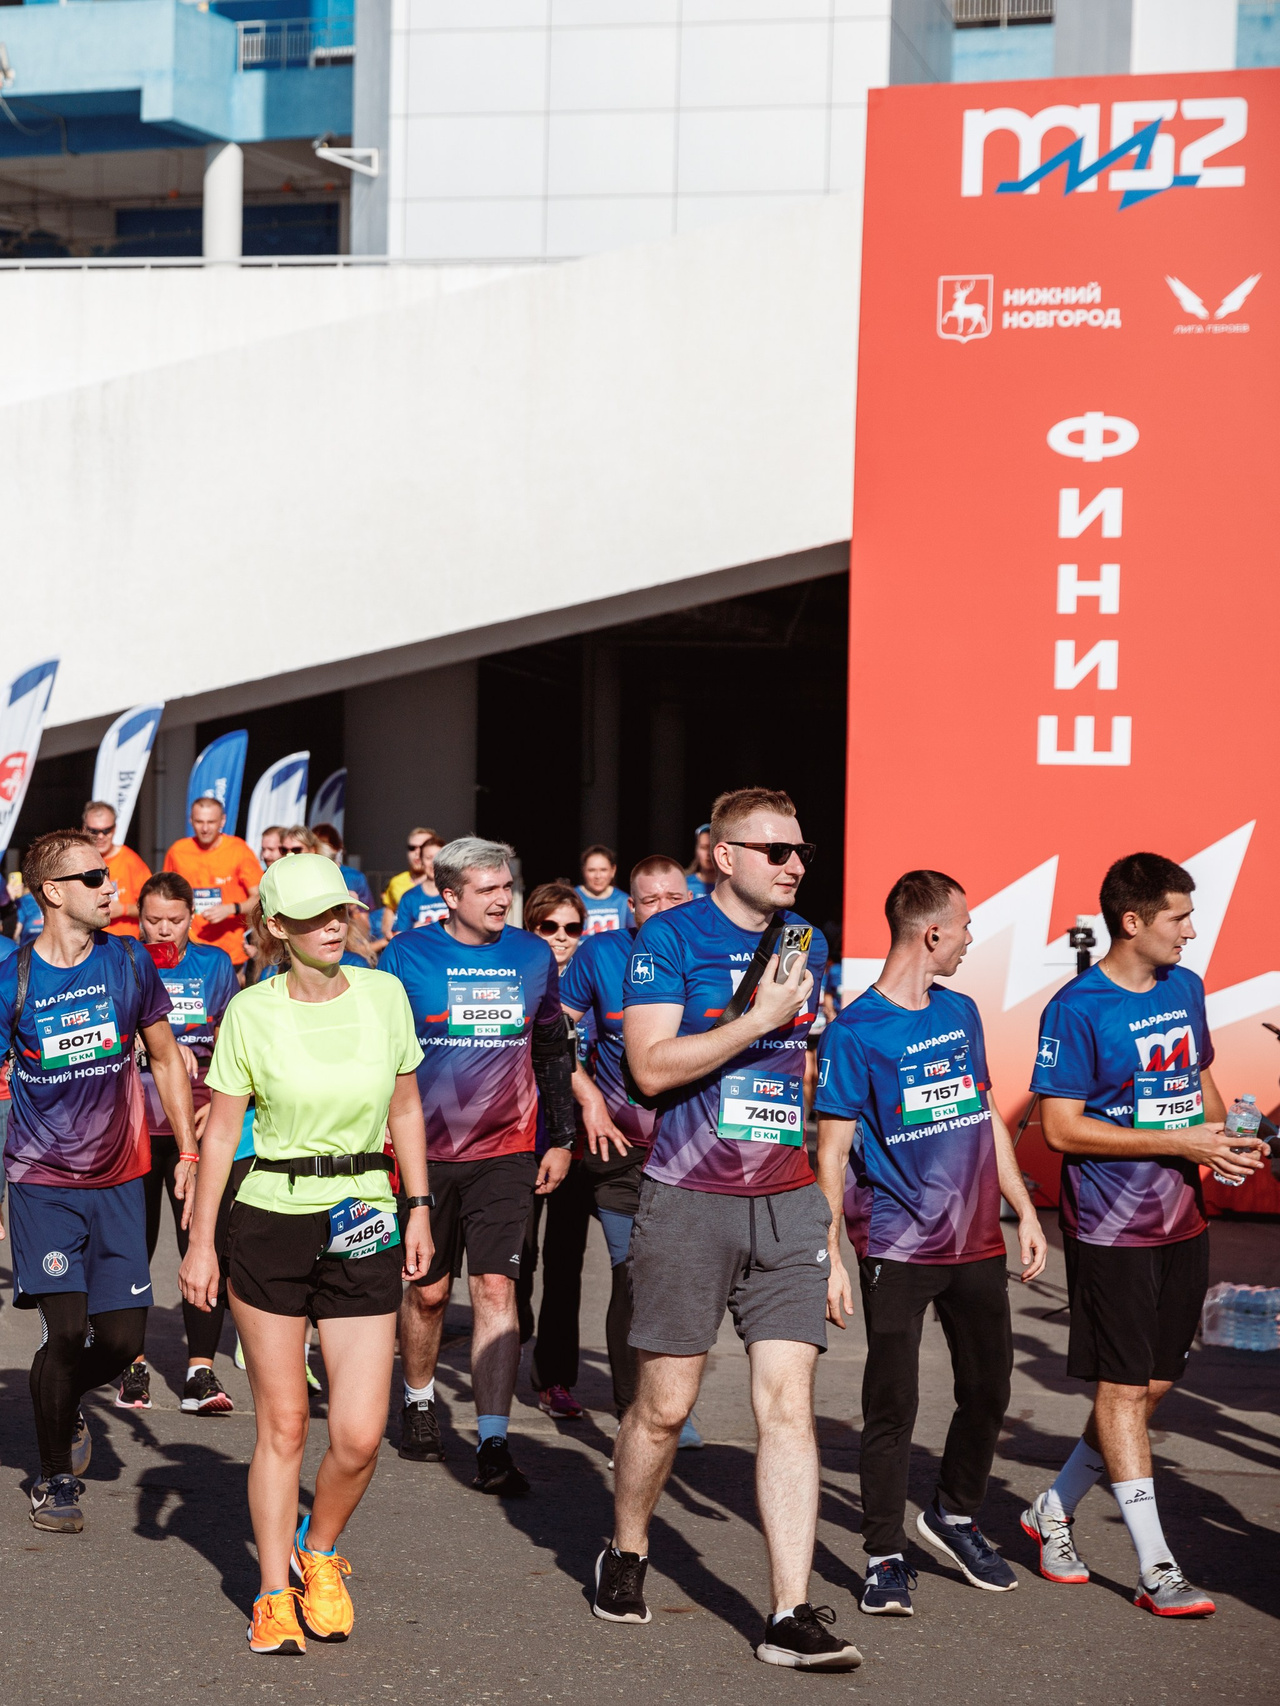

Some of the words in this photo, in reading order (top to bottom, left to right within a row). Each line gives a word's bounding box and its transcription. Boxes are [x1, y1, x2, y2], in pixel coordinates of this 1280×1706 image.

[1003, 282, 1101, 306] НИЖНИЙ
[1002, 307, 1122, 329] НОВГОРОД
[1173, 323, 1204, 335] ЛИГА
[1206, 322, 1250, 334] ГЕРОЕВ
[1037, 411, 1140, 767] ФИНИШ
[446, 967, 517, 977] МАРАФОН
[35, 983, 107, 1009] МАРАФОН
[462, 1009, 513, 1021] 8280
[1128, 1009, 1188, 1032] МАРАФОН
[58, 1031, 103, 1051] 8071
[419, 1037, 472, 1048] НИЖНИЙ
[906, 1029, 966, 1055] МАРАФОН
[70, 1055, 78, 1063] 5
[78, 1051, 94, 1061] KM
[17, 1066, 72, 1084] НИЖНИЙ
[921, 1083, 960, 1104] 7157
[745, 1106, 787, 1124] 7410
[934, 1110, 942, 1118] 5
[943, 1106, 957, 1116] KM
[1156, 1099, 1194, 1117] 7152
[753, 1131, 761, 1139] 5
[763, 1131, 779, 1141] KM
[885, 1119, 949, 1146] НИЖНИЙ
[344, 1219, 386, 1248] 7486
[360, 1245, 375, 1256] KM
